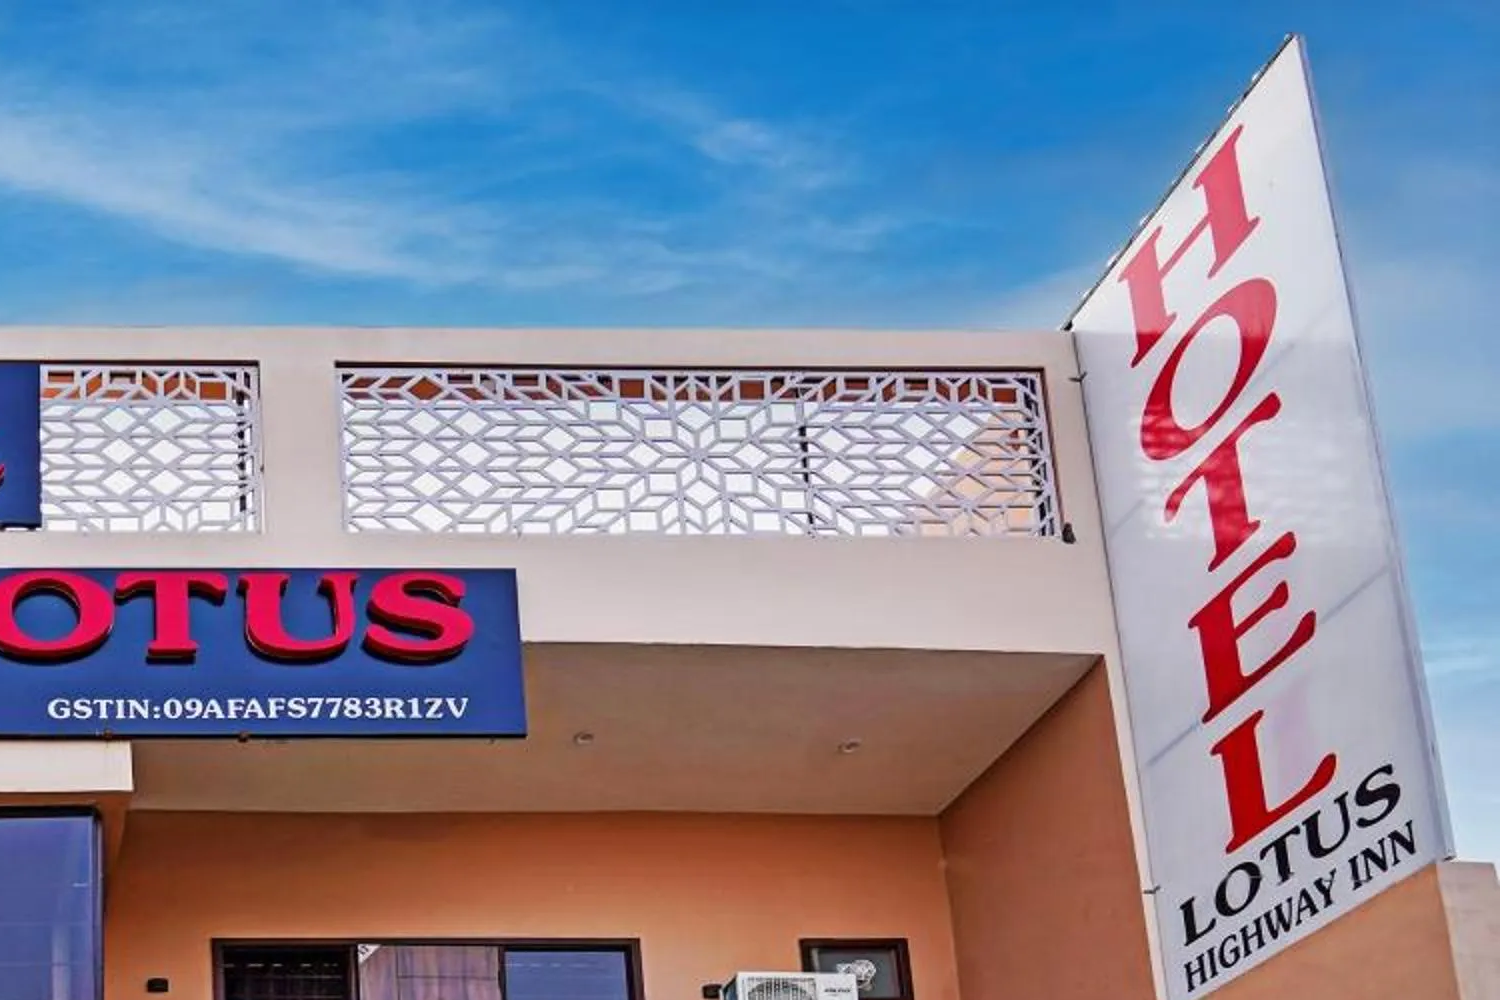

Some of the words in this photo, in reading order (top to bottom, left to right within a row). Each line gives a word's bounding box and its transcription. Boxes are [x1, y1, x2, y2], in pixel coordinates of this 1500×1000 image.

[1118, 124, 1338, 855] HOTEL
[1179, 763, 1402, 947] LOTUS
[1183, 868, 1337, 993] HIGHWAY
[1348, 820, 1417, 892] INN
